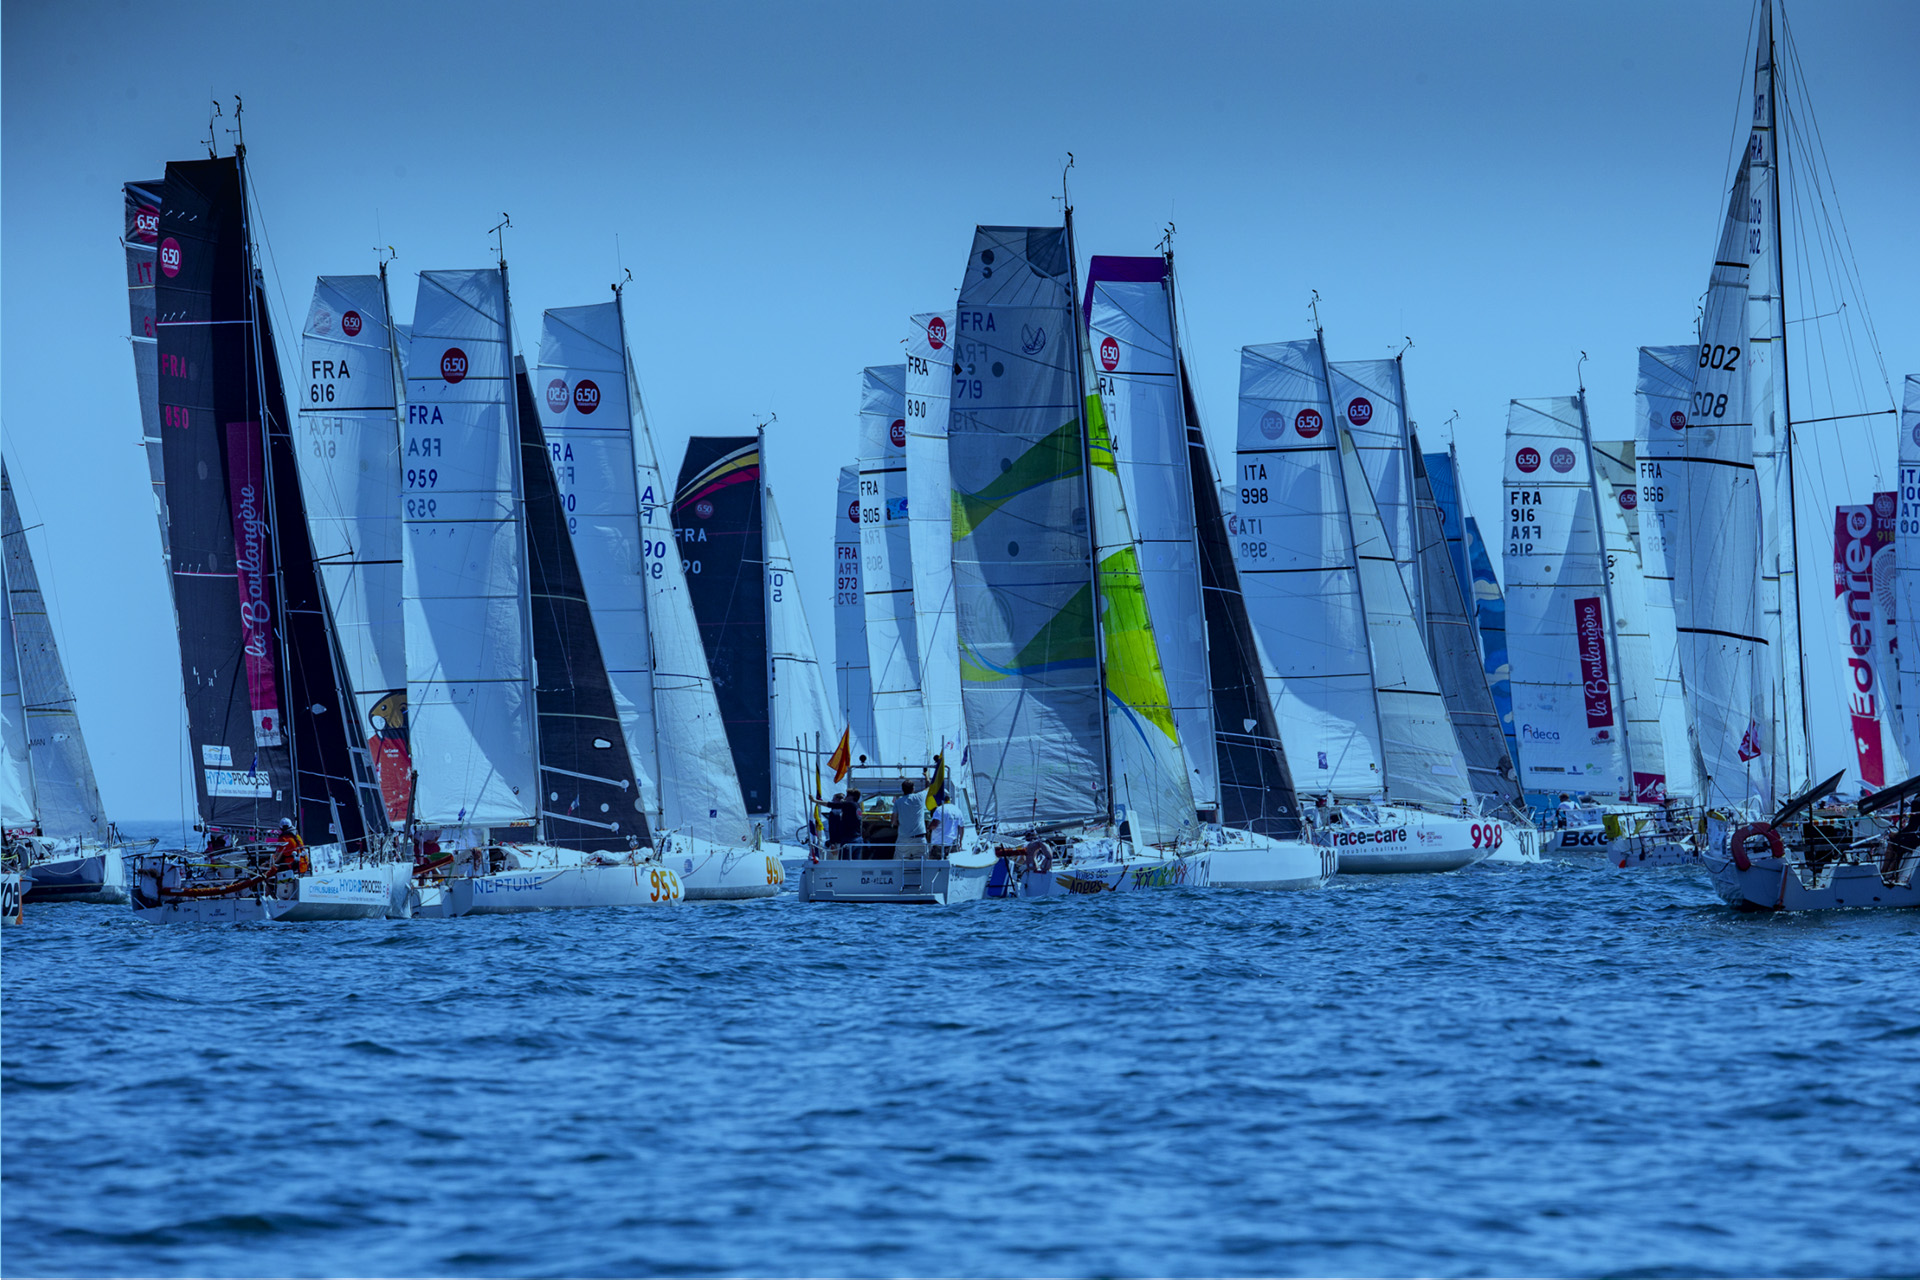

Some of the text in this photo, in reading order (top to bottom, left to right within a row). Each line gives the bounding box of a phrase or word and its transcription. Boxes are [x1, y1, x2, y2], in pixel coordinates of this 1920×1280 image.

[162, 248, 180, 265] 6.50
[137, 263, 153, 283] IT
[344, 316, 360, 328] 6.50
[961, 312, 996, 332] FRA
[1102, 346, 1118, 360] 6.50
[1700, 344, 1741, 372] 802
[162, 354, 187, 379] FRA
[312, 360, 351, 379] FRA
[443, 357, 466, 372] 6.50
[908, 356, 929, 376] FRA
[311, 384, 335, 402] 616
[576, 388, 598, 402] 6.50
[956, 380, 983, 399] 719
[1099, 377, 1115, 396] RA
[165, 405, 189, 429] 850
[409, 405, 444, 424] FRA
[908, 400, 926, 418] 890
[1350, 405, 1370, 416] 6.50
[1298, 415, 1320, 428] 6.50
[1517, 454, 1539, 465] 6.50
[407, 469, 438, 488] 959
[1244, 463, 1268, 481] ITA
[1640, 462, 1663, 479] FRA
[1901, 469, 1920, 484] IT
[860, 481, 879, 496] FRA
[1241, 488, 1268, 504] 998
[1643, 486, 1664, 502] 966
[1901, 486, 1920, 500] 10
[1511, 491, 1542, 505] FRA
[850, 504, 860, 516] 6.5
[863, 508, 880, 523] 905
[1511, 508, 1535, 522] 916
[838, 547, 857, 560] FRA
[838, 577, 857, 590] 973
[1838, 505, 1876, 717] Edenred
[244, 631, 267, 658] la
[1586, 699, 1608, 717] la
[1470, 823, 1503, 849] 998
[1341, 845, 1408, 855] double challenge
[474, 876, 543, 894] NEPTUNE
[650, 870, 679, 902] 959
